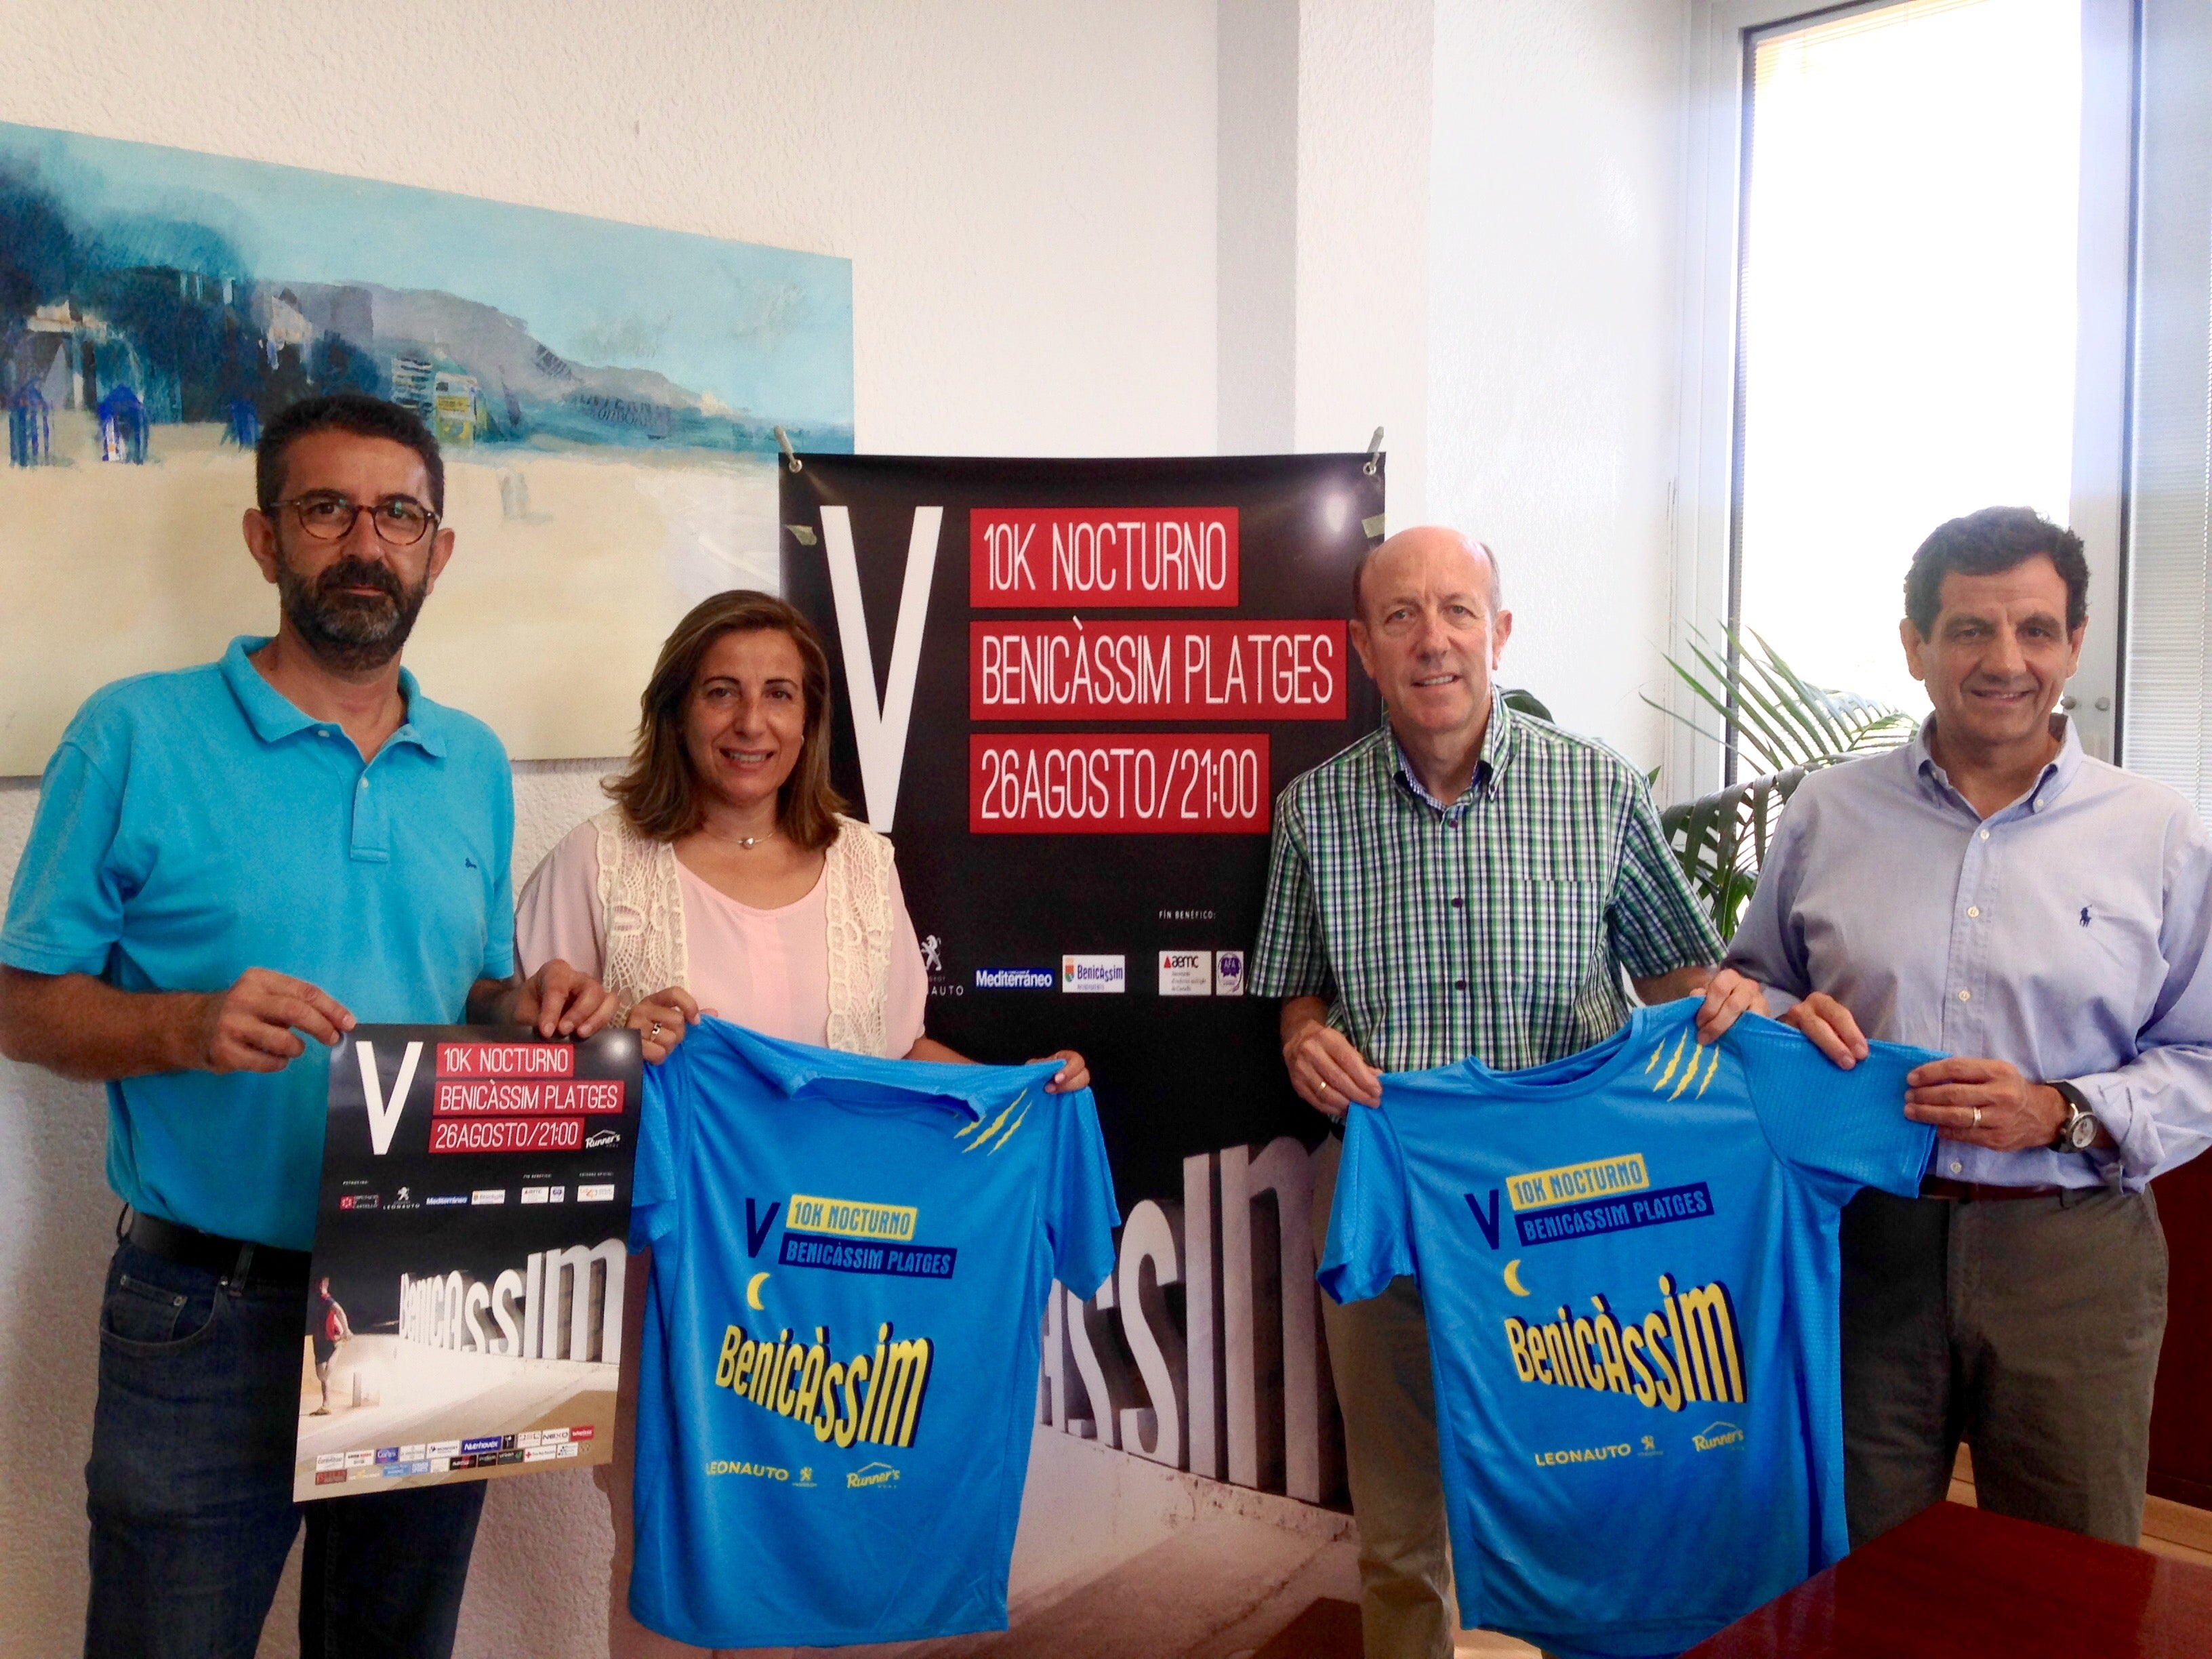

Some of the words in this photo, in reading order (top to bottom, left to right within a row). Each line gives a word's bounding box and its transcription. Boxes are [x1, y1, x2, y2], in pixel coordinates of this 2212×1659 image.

[984, 523, 1036, 591] 10K
[1052, 521, 1227, 592] NOCTURNO
[820, 506, 943, 833] V
[983, 615, 1170, 705] BENICÀSSIM
[1185, 634, 1334, 705] PLATGES
[981, 747, 1258, 820] 26AGOSTO/21:00
[931, 985, 964, 996] AUTO
[976, 969, 1052, 987] Mediterráneo
[445, 1048, 472, 1073] 10K
[479, 1047, 569, 1073] NOCTURNO
[355, 1041, 424, 1155] V
[439, 1079, 540, 1111] BENICÀSSIM
[544, 1084, 619, 1109] PLATGES
[434, 1121, 579, 1150] 26AGOSTO/21:00
[1513, 1180, 1546, 1206] 10K
[1549, 1159, 1644, 1197] NOCTURNO
[746, 1197, 781, 1258] V
[794, 1202, 822, 1227] 10K
[827, 1204, 912, 1236] NOCTURNO
[1464, 1189, 1500, 1250] V
[1523, 1203, 1630, 1242] BENICÀSSIM
[1635, 1190, 1707, 1225] PLATGES
[785, 1240, 884, 1270] BENICÀSSIM
[886, 1250, 952, 1275] PLATGES
[1535, 1443, 1631, 1467] LEONAUTO
[1692, 1429, 1744, 1452] Runner's
[705, 1460, 789, 1481] LEONAUTO
[846, 1469, 901, 1489] Runner's
